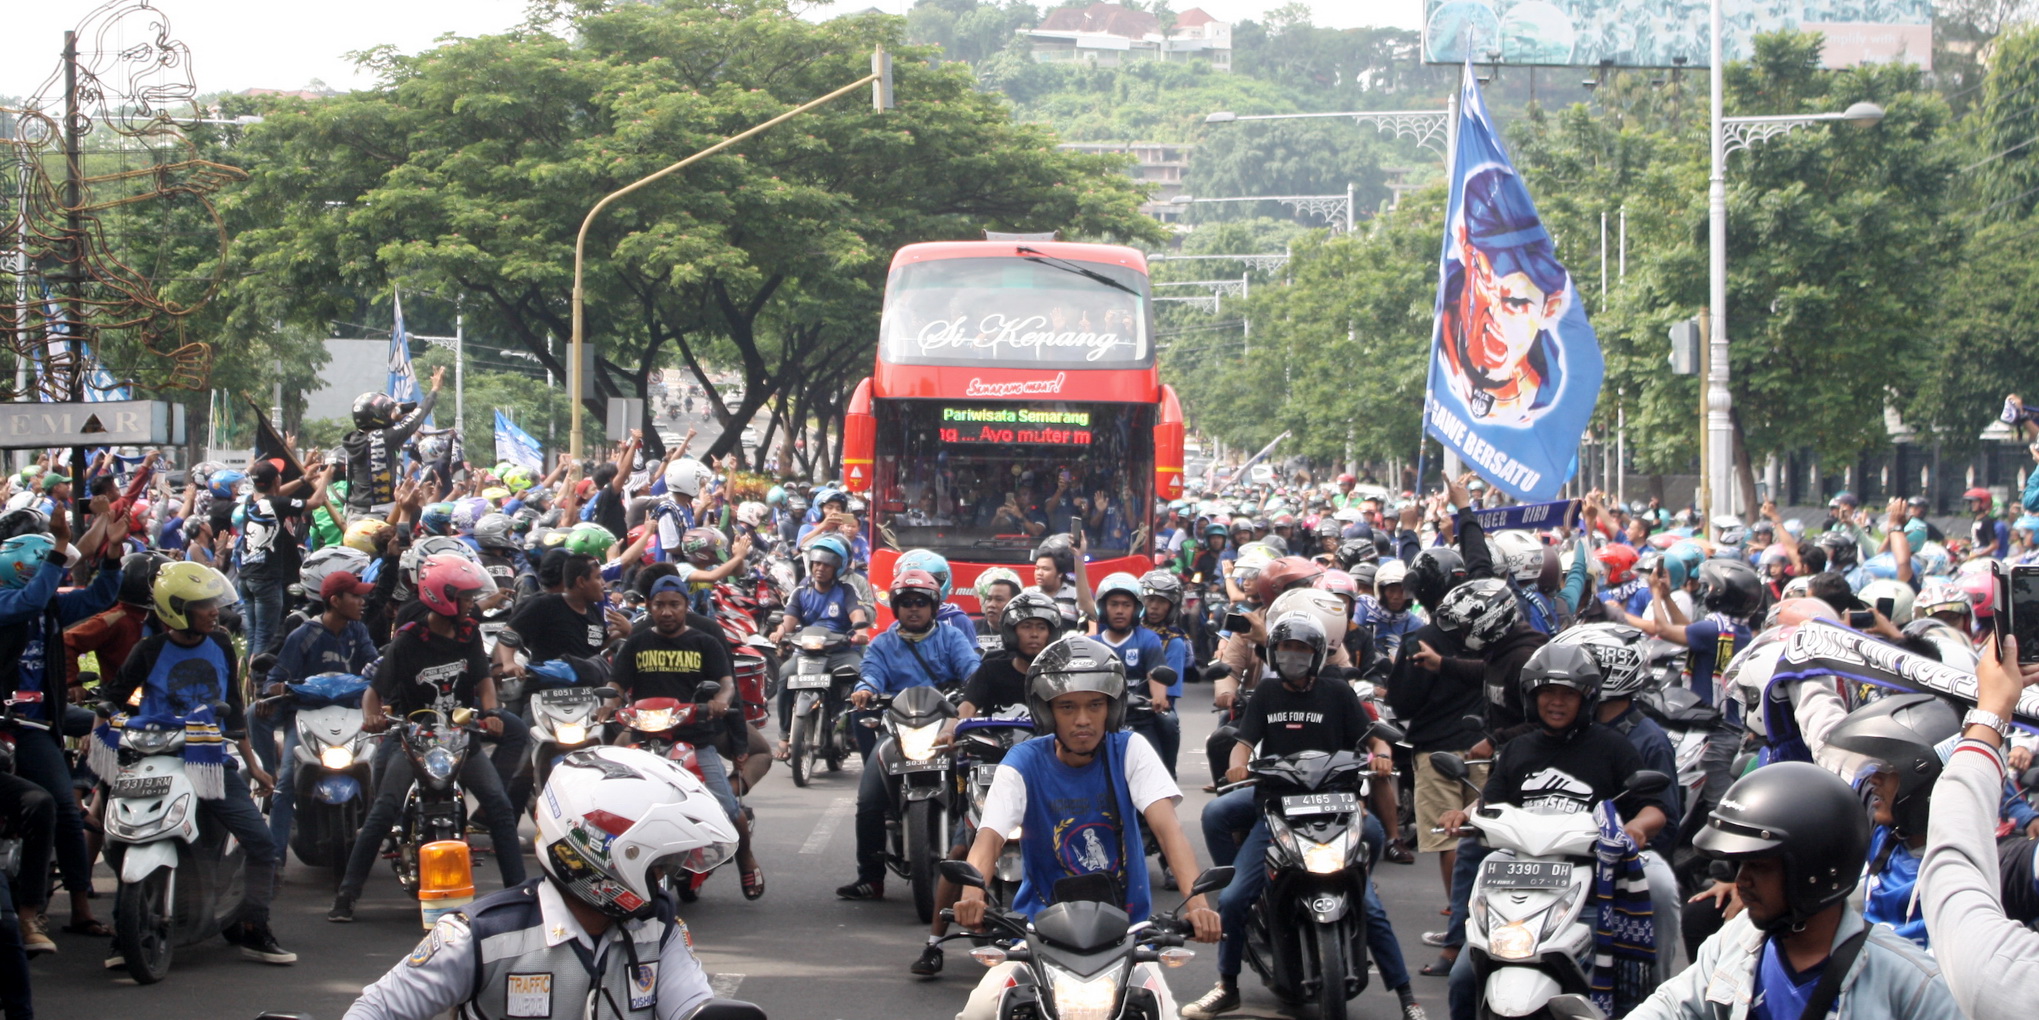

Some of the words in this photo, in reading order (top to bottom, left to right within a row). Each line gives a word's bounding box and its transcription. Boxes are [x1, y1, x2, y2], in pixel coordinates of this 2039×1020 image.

[917, 315, 968, 356] Si
[973, 313, 1119, 361] Kenang
[10, 411, 140, 436] EMAR
[943, 408, 1016, 422] Pariwisata
[1018, 409, 1090, 426] Semarang
[980, 426, 1014, 443] Ayo
[1017, 428, 1072, 443] muter
[1462, 431, 1541, 492] BERSATU
[636, 650, 702, 669] CONGYANG
[1267, 712, 1287, 724] MADE
[1289, 712, 1305, 721] FOR
[1306, 712, 1323, 723] FUN
[980, 766, 987, 775] H
[123, 778, 153, 789] 3319
[156, 777, 172, 787] RM
[1283, 797, 1291, 806] H
[1302, 794, 1330, 805] 4165
[1339, 793, 1353, 803] TJ
[1487, 863, 1496, 874] H
[1507, 863, 1540, 875] 3390
[1551, 864, 1570, 876] DH
[509, 976, 550, 994] TRAFFIC
